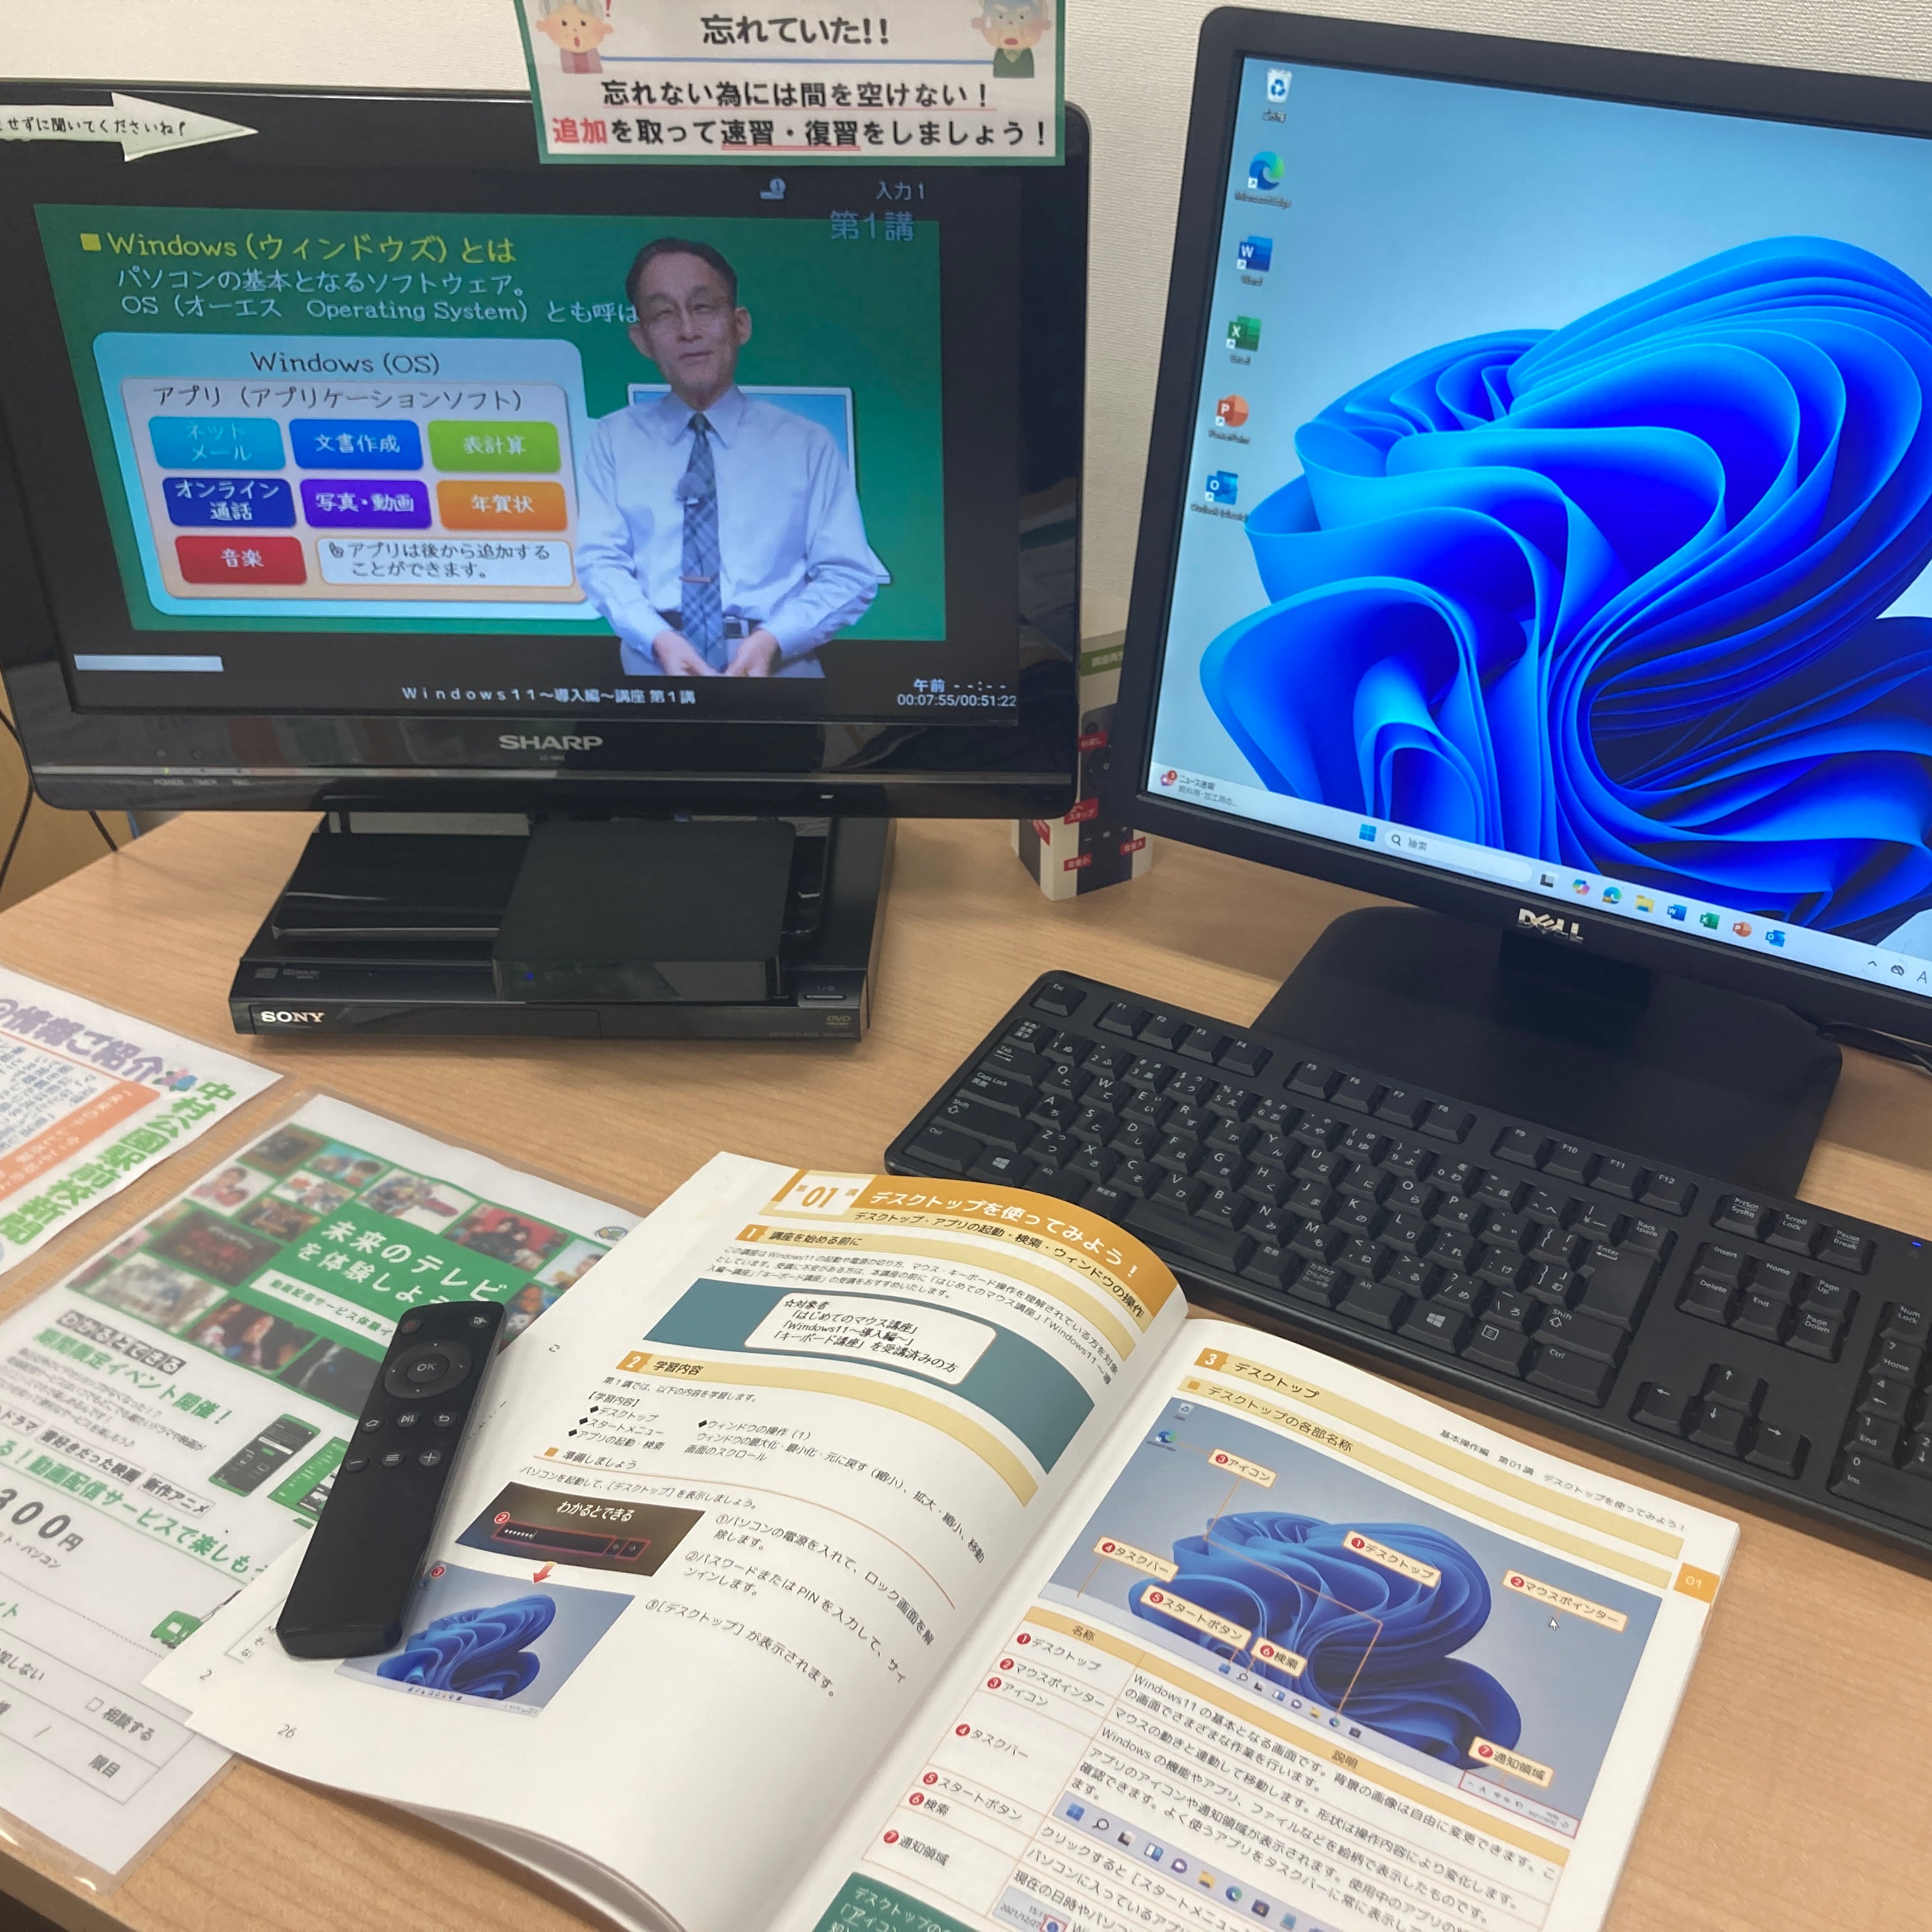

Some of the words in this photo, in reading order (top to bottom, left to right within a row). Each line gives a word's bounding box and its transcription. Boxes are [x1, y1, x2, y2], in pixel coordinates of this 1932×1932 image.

[603, 82, 988, 108] 忘れない為には間を空けない！
[552, 117, 1047, 146] 追加を取って速習・復習をしましょう！
[830, 210, 916, 243] 第1講
[118, 265, 526, 298] パソコンの基本となるソフトウェア。
[307, 300, 425, 323] Operating
[184, 423, 248, 441] ネット
[190, 444, 252, 461] メール
[314, 433, 401, 455] 文書作成
[463, 435, 527, 455] 表計算
[174, 480, 280, 500] オンライン
[210, 500, 253, 522] 通話
[315, 493, 415, 514] 写真・動画
[471, 494, 535, 514] 年賀状
[220, 548, 264, 568] 音楽
[348, 542, 551, 561] アプリは後から追加する
[352, 562, 488, 579] ことができます。
[896, 694, 1017, 707] 00:07:55/00:51:22
[498, 735, 604, 751] SHARP
[1517, 908, 1584, 943] DELL
[260, 1010, 325, 1023] SONY
[1057, 1065, 1069, 1076] Q
[1098, 1078, 1113, 1089] W
[870, 1191, 1140, 1278] デスクトップを使ってみよう！
[1637, 1220, 1657, 1231] Back
[769, 1230, 861, 1248] 講座を始める前に
[1833, 1237, 1859, 1250] Break
[321, 1220, 508, 1302] 未来のテレビ
[1597, 1245, 1620, 1256] Enter
[853, 1211, 1146, 1320] デスクトップ・アプリの起動・検索・ウィンドウの操作
[1699, 1279, 1728, 1294] Delete
[1818, 1279, 1841, 1292] Page
[1818, 1286, 1830, 1295] Up
[1752, 1296, 1770, 1307] End
[56, 1310, 187, 1376] わかるとできる
[417, 1360, 436, 1374] OK
[652, 1360, 705, 1376] 学習内容
[1233, 1360, 1321, 1400] デスクトップ
[1208, 1385, 1354, 1453] デスクトップの各部名称
[563, 1450, 638, 1469] 準備しましょう
[684, 1443, 767, 1462] 画面のスクロール
[1228, 1455, 1271, 1483] アイコン
[142, 1477, 210, 1514] 新作アニメ
[556, 1500, 635, 1523] わかるとできる
[1114, 1546, 1170, 1575] タスクバー
[1364, 1543, 1436, 1584] デスクトップ
[1524, 1579, 1621, 1626] マウスポインター
[1162, 1597, 1244, 1641] スタートボタン
[1071, 1624, 1096, 1643] 名称
[1031, 1637, 1103, 1671] デスクトップ
[1273, 1650, 1300, 1671] 検索
[1001, 1681, 1050, 1707] アイコン
[1016, 1662, 1107, 1710] マウスポインター
[277, 1724, 297, 1738] 26
[970, 1728, 1030, 1760] タスクバー
[1492, 1751, 1547, 1781] 通知領域
[937, 1775, 1023, 1821] スタートボタン
[1071, 1781, 1101, 1803] ます。
[924, 1797, 951, 1818] 検索
